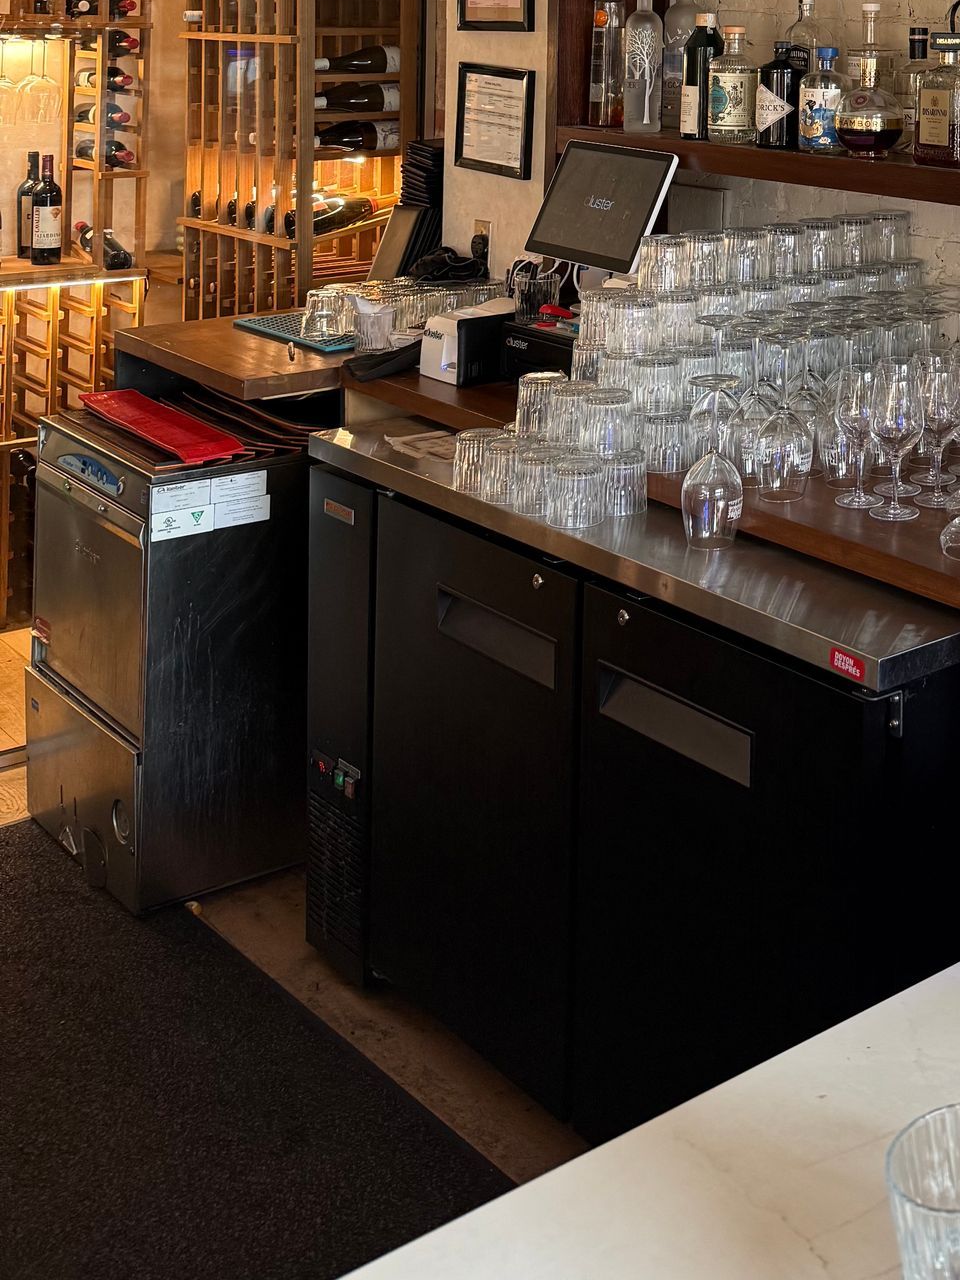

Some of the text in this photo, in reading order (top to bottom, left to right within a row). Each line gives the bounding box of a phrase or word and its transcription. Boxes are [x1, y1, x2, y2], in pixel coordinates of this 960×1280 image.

[584, 195, 615, 210] cluster
[506, 336, 528, 350] cluster
[834, 651, 854, 666] DOYON
